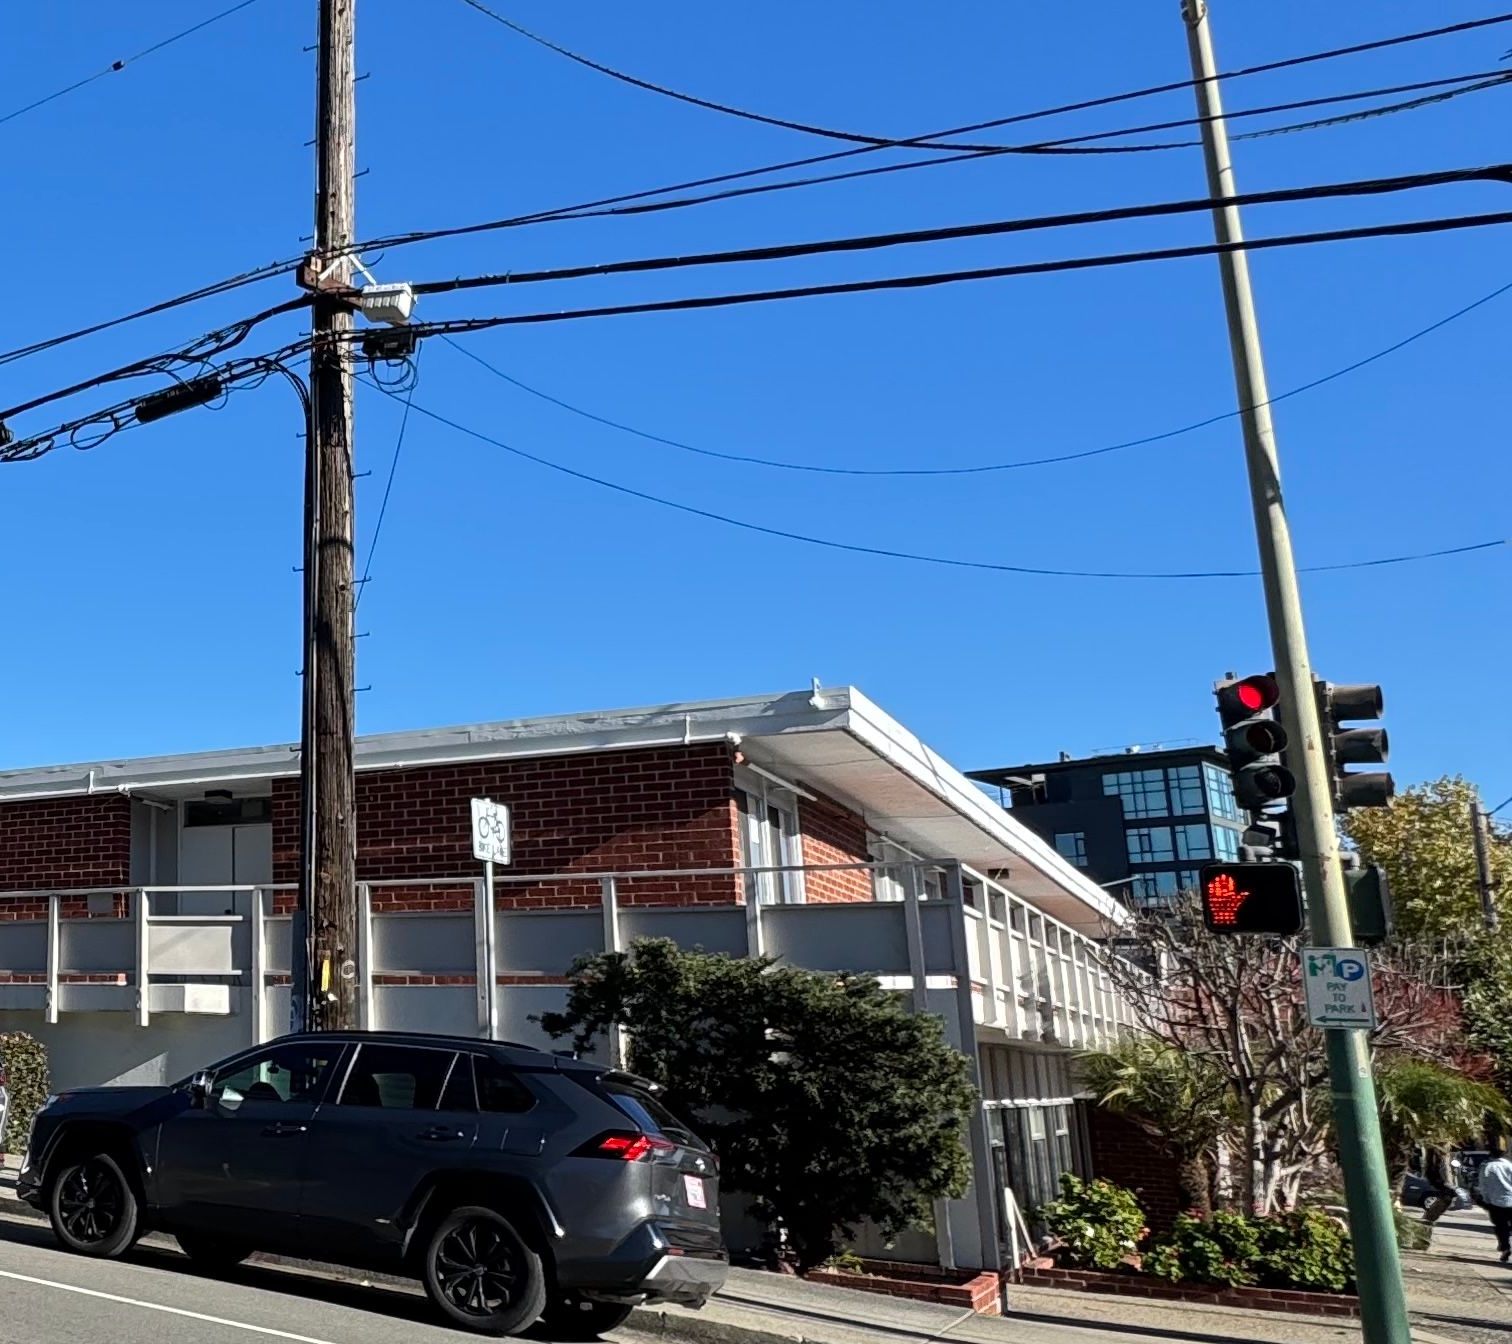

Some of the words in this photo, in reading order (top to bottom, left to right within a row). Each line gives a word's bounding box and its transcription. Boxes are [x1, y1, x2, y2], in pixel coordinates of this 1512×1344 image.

[1327, 982, 1347, 991] PAY
[1333, 993, 1346, 1002] TO
[1324, 1004, 1356, 1013] PARK
